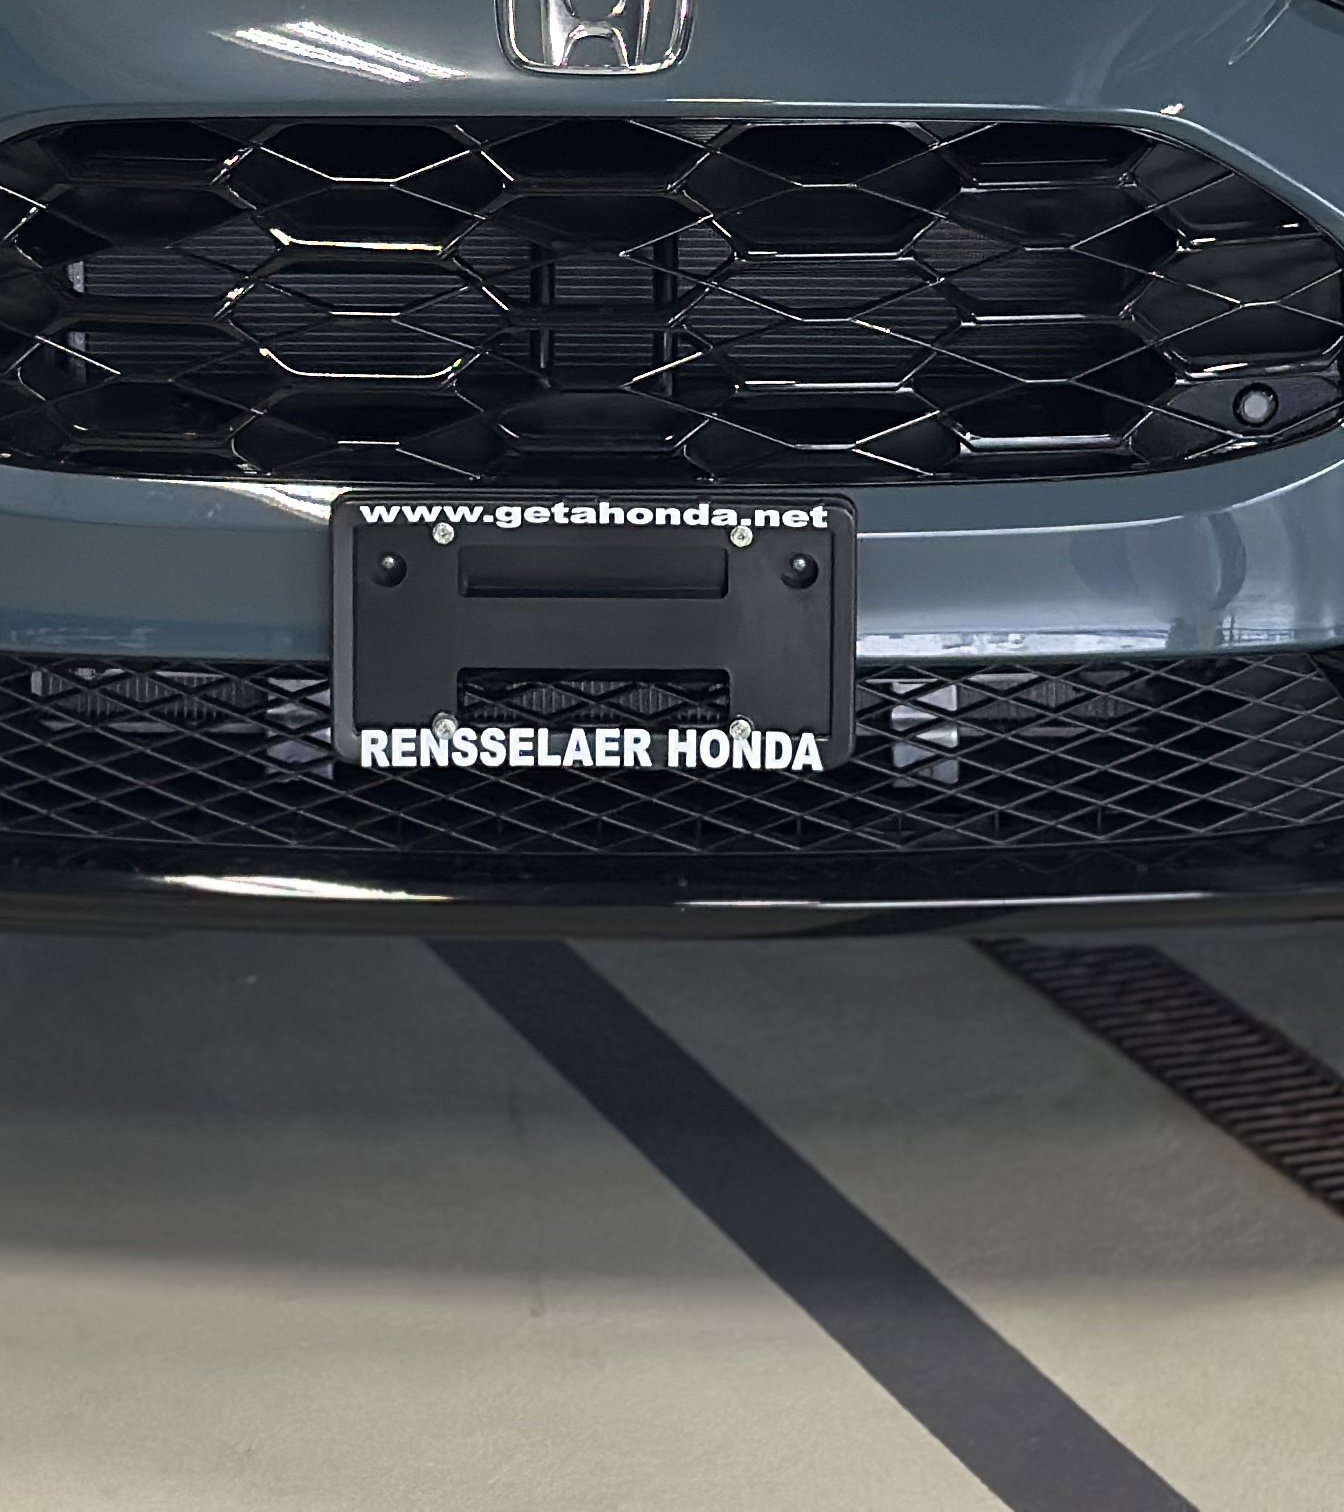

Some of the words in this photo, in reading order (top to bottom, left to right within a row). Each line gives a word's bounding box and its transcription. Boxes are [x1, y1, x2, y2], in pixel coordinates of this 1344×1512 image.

[360, 501, 828, 528] www.getahonda.net
[360, 728, 653, 768] RENSSELAER
[667, 730, 824, 771] HONDA
